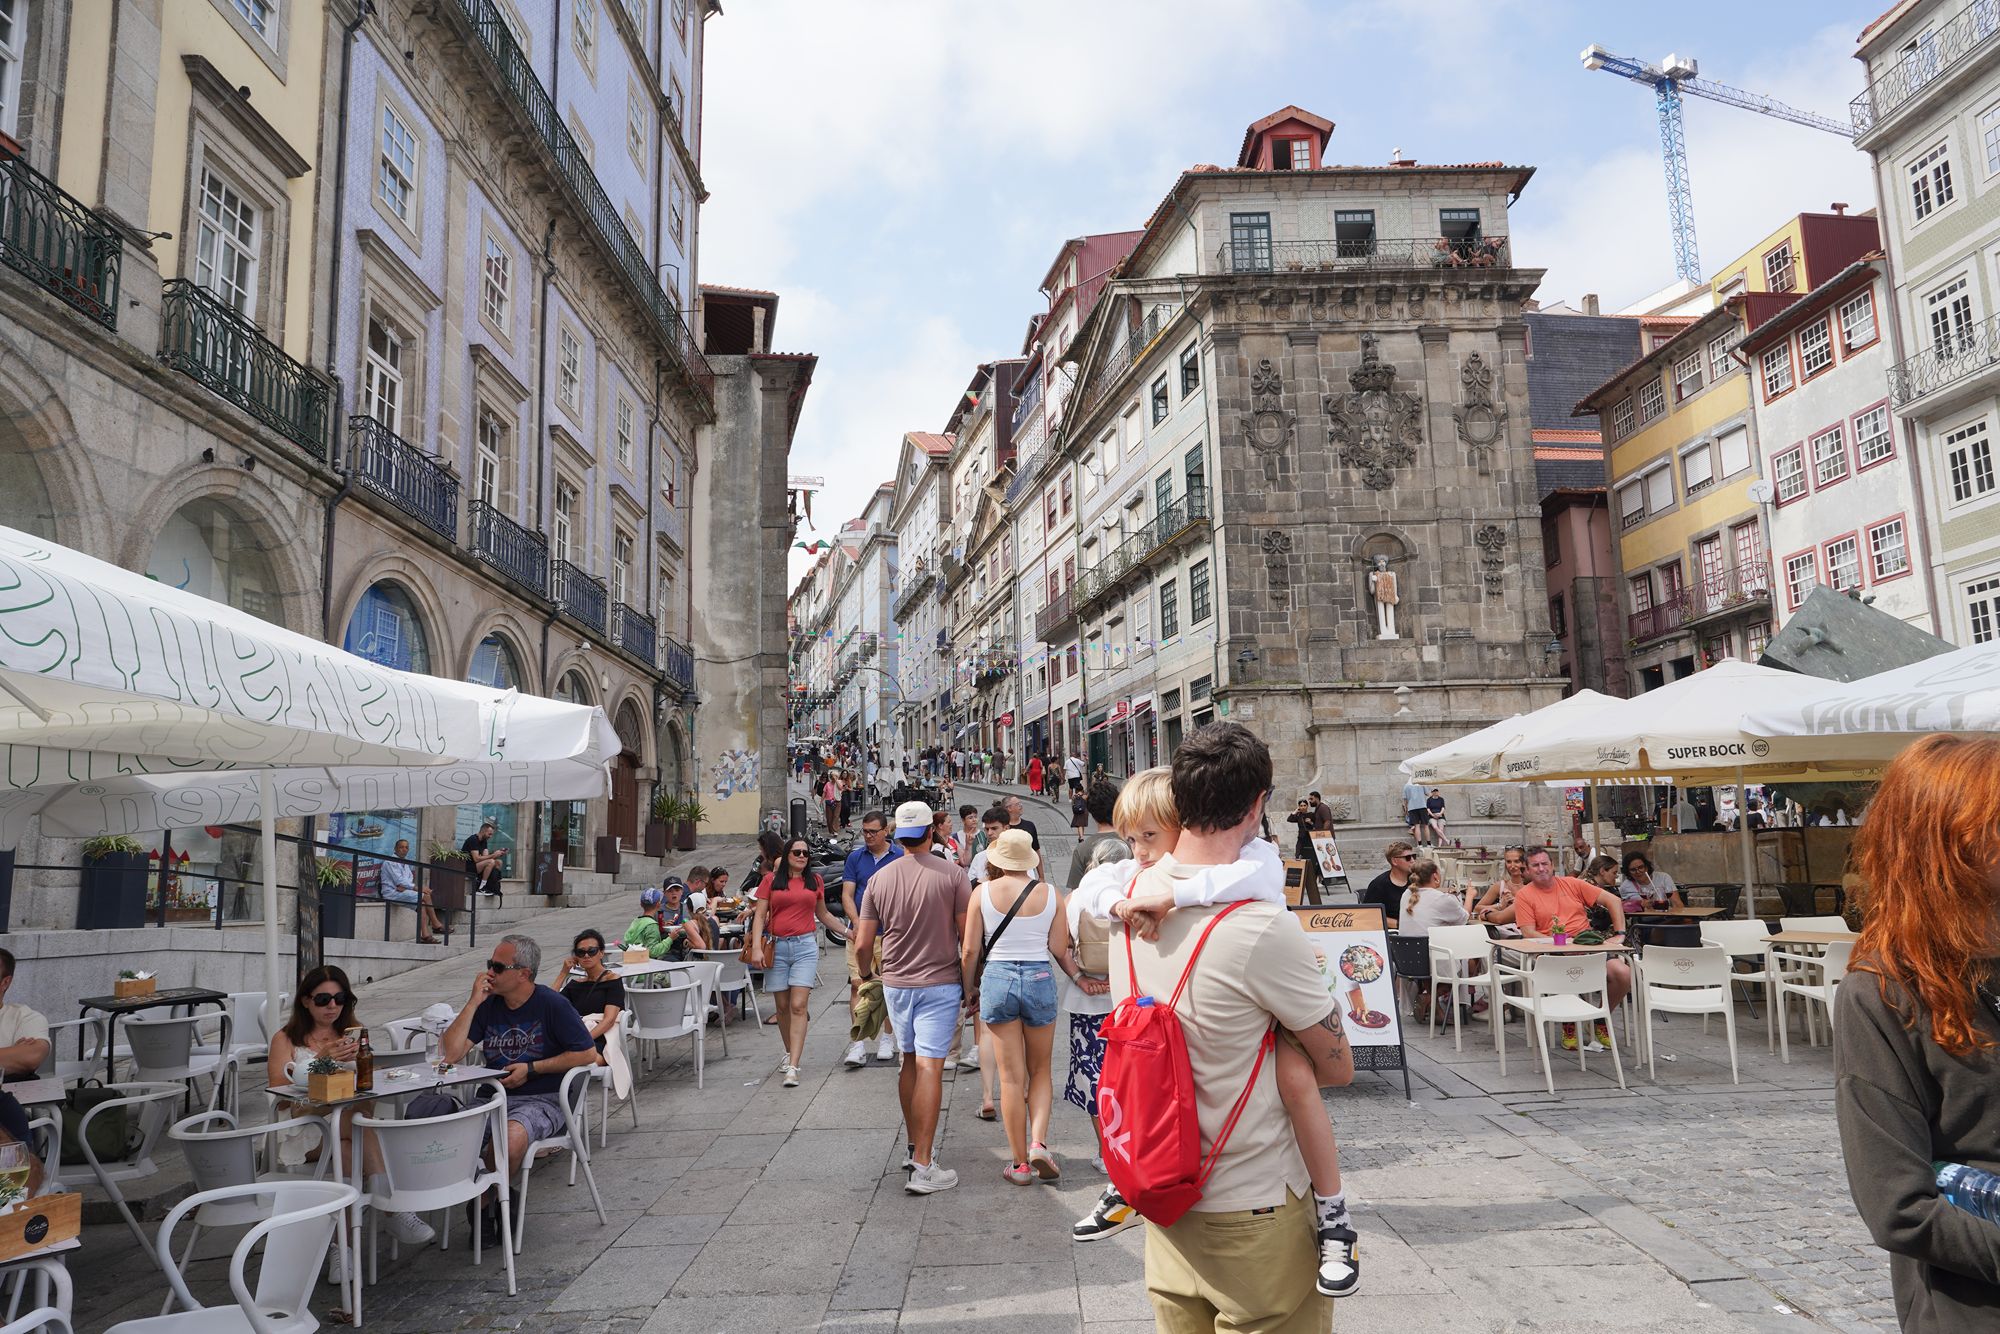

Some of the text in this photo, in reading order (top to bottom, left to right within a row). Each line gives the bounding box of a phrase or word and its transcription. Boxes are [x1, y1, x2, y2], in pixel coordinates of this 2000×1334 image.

[1667, 743, 1746, 760] SUPER BOCK
[1506, 763, 1521, 774] SUPER
[1310, 912, 1355, 928] Coca-Cola
[1673, 960, 1695, 968] SAGRES
[1565, 968, 1584, 976] SAGRES
[489, 1033, 536, 1048] Hard Rock
